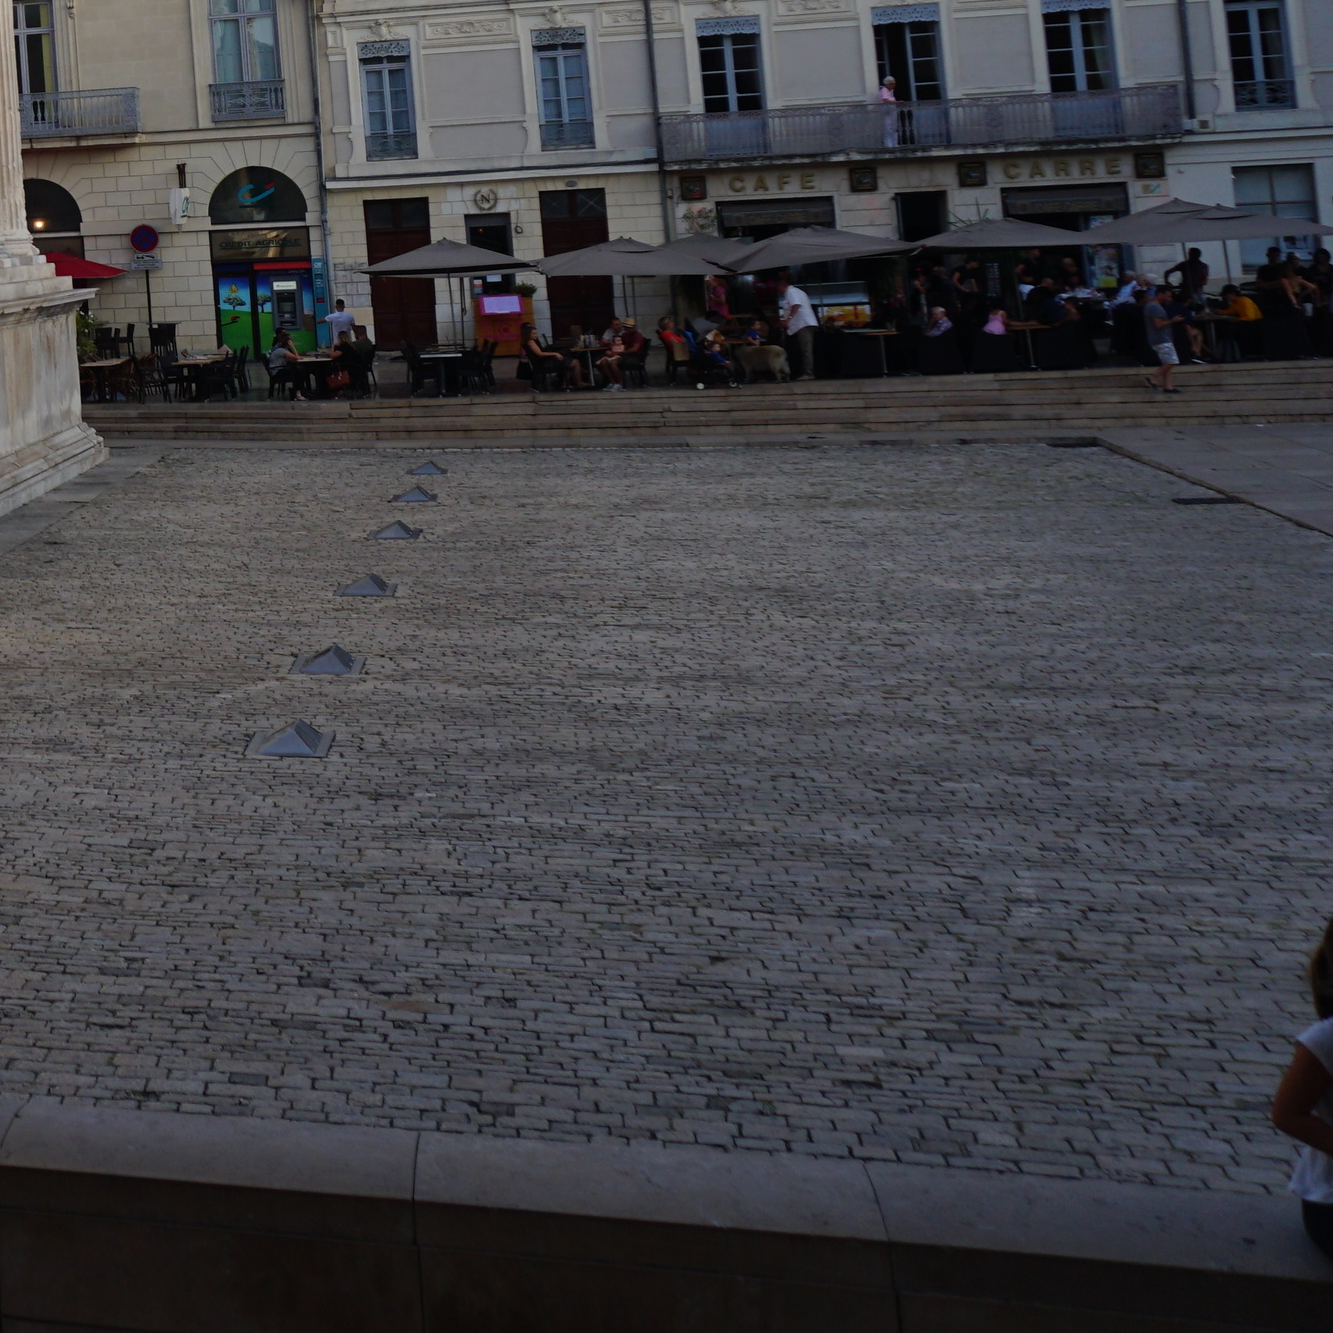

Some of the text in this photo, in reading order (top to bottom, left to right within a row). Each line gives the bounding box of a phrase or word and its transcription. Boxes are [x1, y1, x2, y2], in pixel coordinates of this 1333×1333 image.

[729, 156, 1121, 193] CAFE CARRE
[480, 194, 491, 204] N
[256, 238, 301, 246] AGRICOLE
